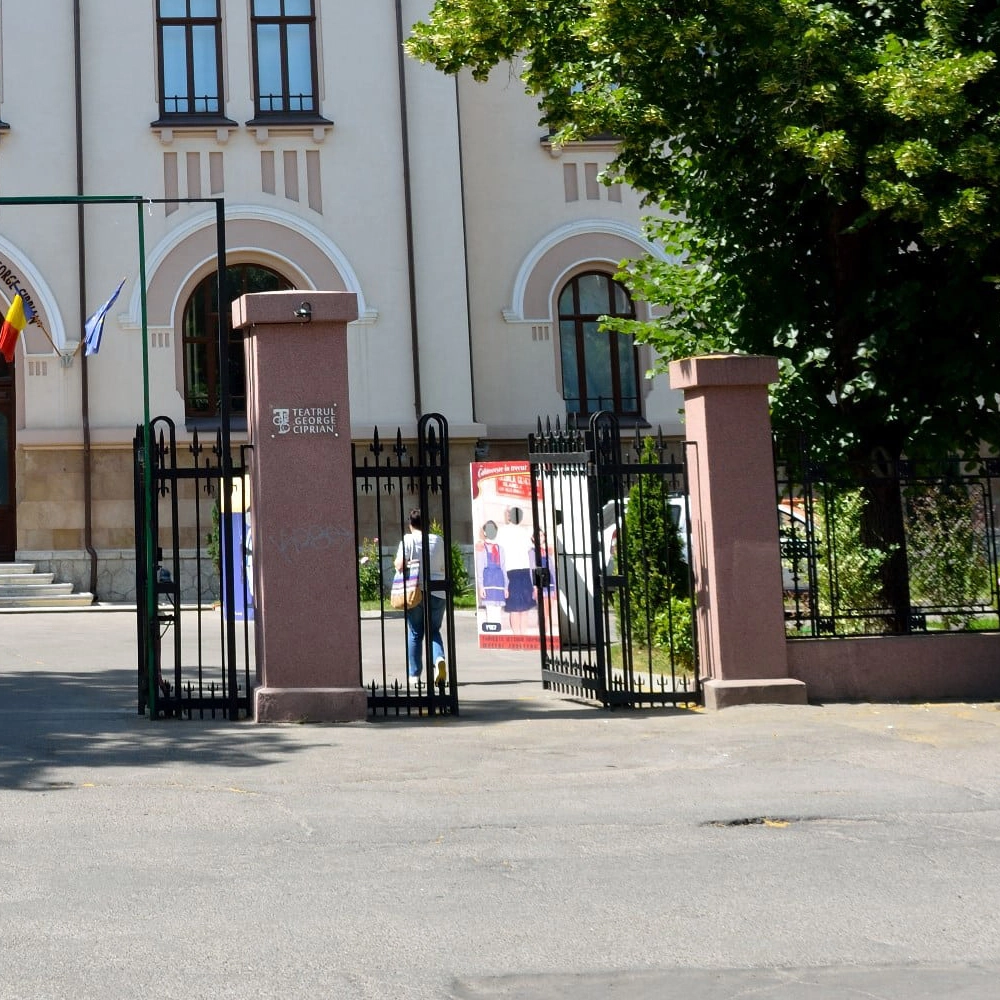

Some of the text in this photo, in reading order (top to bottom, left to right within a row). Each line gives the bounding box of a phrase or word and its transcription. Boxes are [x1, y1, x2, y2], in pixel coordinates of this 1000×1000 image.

[292, 408, 336, 417] TEATRUL
[294, 416, 337, 425] GEORGE
[293, 425, 334, 434] CIPRIAN
